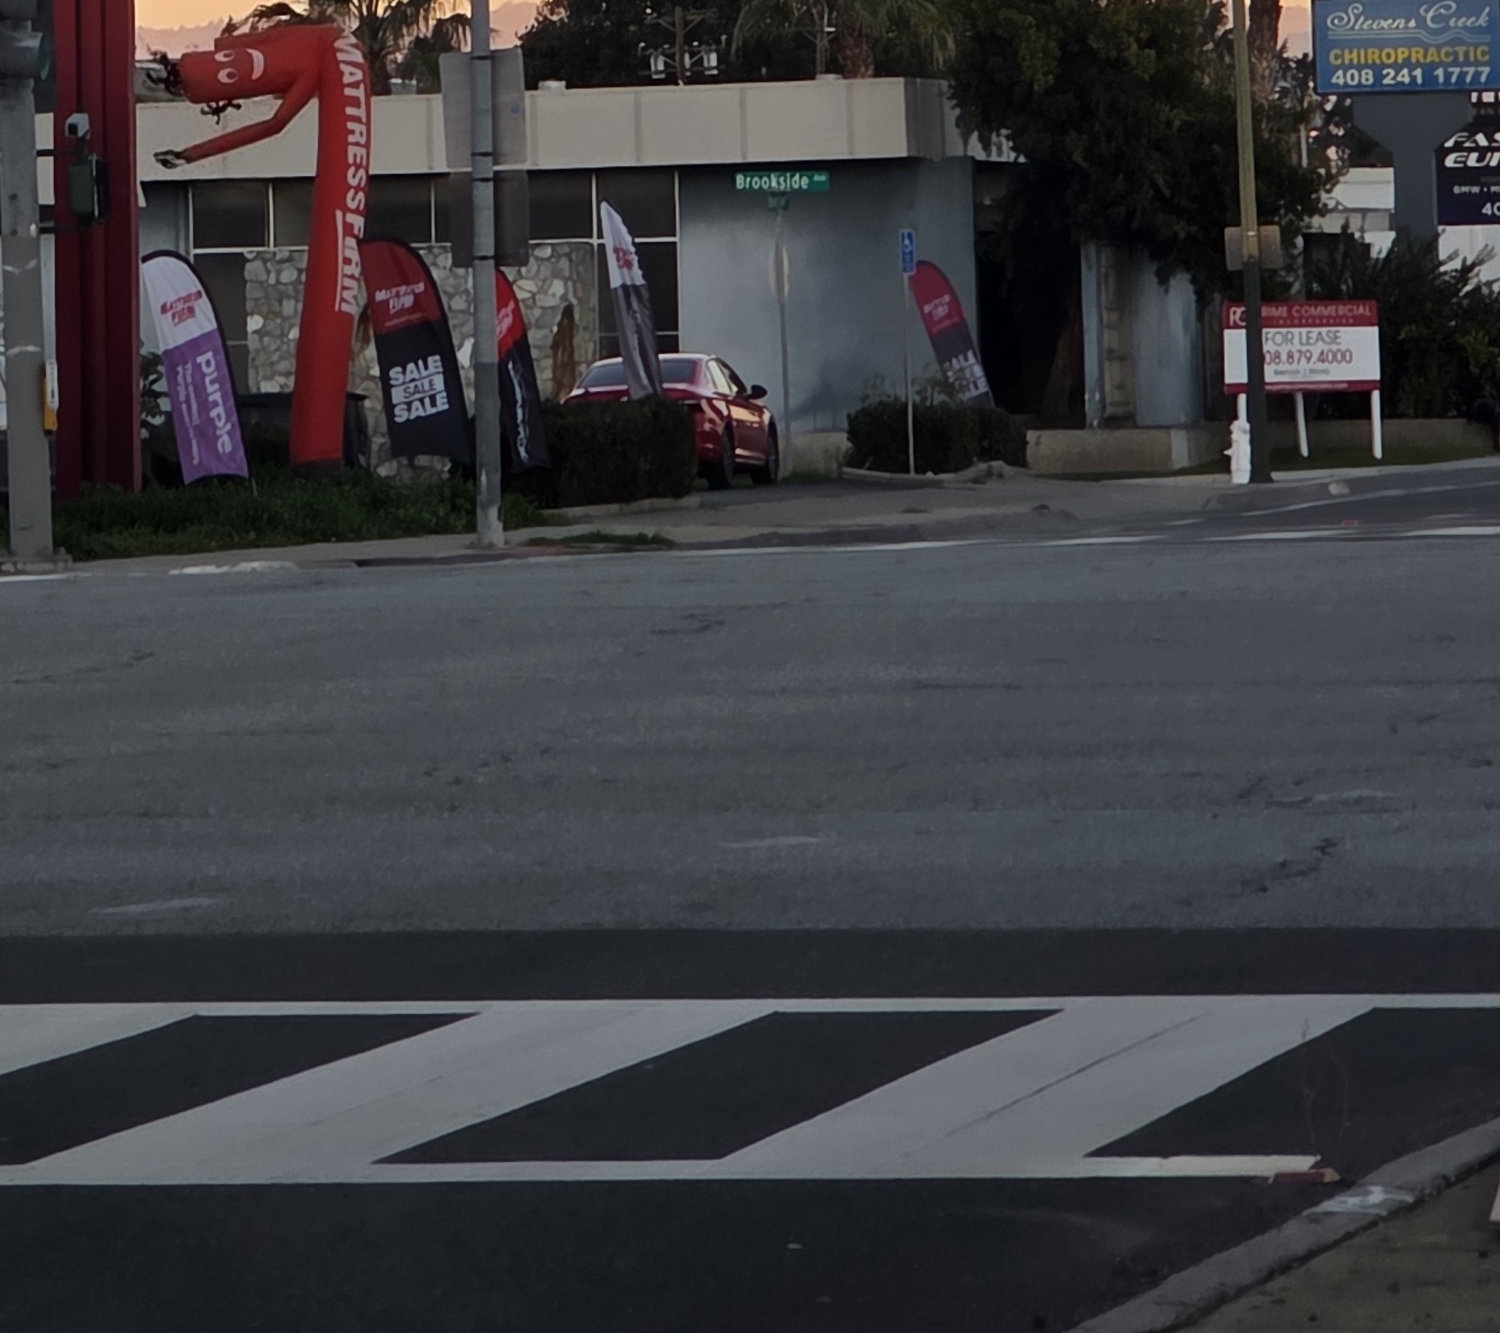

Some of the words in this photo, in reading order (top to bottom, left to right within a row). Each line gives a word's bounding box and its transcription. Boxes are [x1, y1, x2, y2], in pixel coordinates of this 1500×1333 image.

[1327, 3, 1416, 30] Stevens
[1420, 0, 1491, 28] Creek
[1329, 45, 1490, 65] CHIROPRACTIC
[1331, 68, 1374, 86] 408
[1382, 67, 1423, 86] 241
[1434, 66, 1491, 85] 1777
[334, 30, 367, 211] MATTRESS
[736, 172, 809, 189] Brookside
[338, 212, 366, 315] FIRM
[1264, 331, 1295, 346] FOR
[1299, 330, 1342, 346] LEASE
[1265, 348, 1353, 365] 08.879.4000
[389, 354, 443, 385] SALE
[403, 379, 436, 399] SALE
[196, 351, 233, 455] purple
[394, 392, 449, 423] SALE
